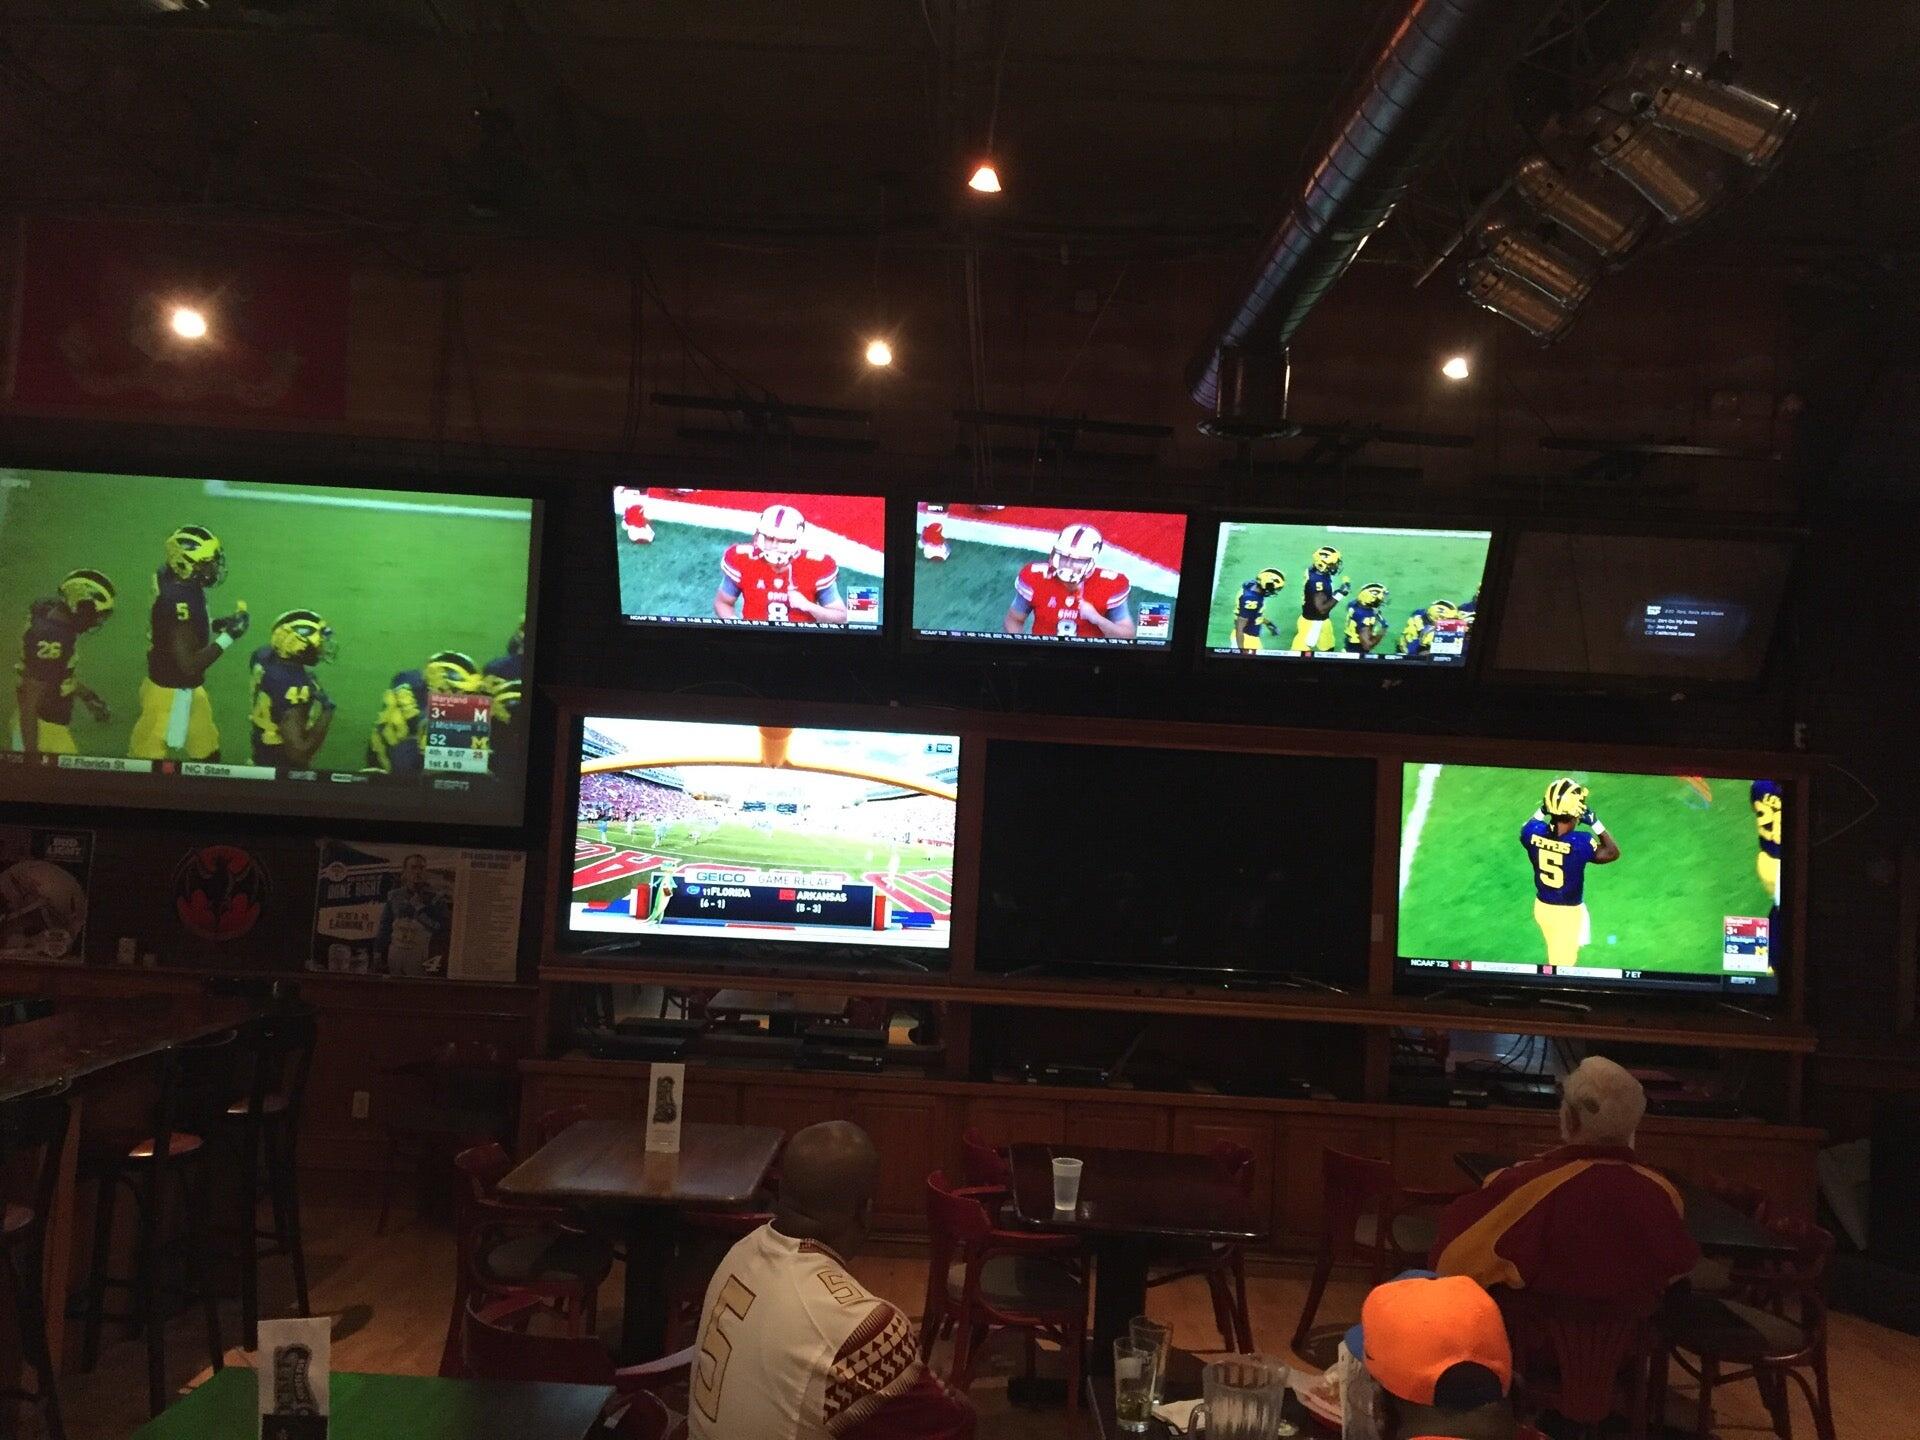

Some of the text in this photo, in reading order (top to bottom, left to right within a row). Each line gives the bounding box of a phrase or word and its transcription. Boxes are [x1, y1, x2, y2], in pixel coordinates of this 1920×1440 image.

[174, 602, 190, 620] 5
[37, 640, 62, 660] 26
[431, 708, 488, 722] 3 M
[430, 734, 446, 745] 52
[74, 758, 110, 769] Florida
[114, 760, 125, 770] St
[184, 765, 230, 776] NC State
[1530, 834, 1572, 854] PEPPERS
[1538, 848, 1564, 889] 5
[696, 872, 832, 887] GEICO GAME RECAP
[711, 887, 751, 898] FLORIDA
[796, 891, 848, 903] ARKANSAS
[1726, 926, 1733, 934] 3
[1726, 944, 1739, 954] 52
[422, 955, 442, 973] 4
[817, 1270, 864, 1304] 5
[694, 1274, 756, 1423] 5
